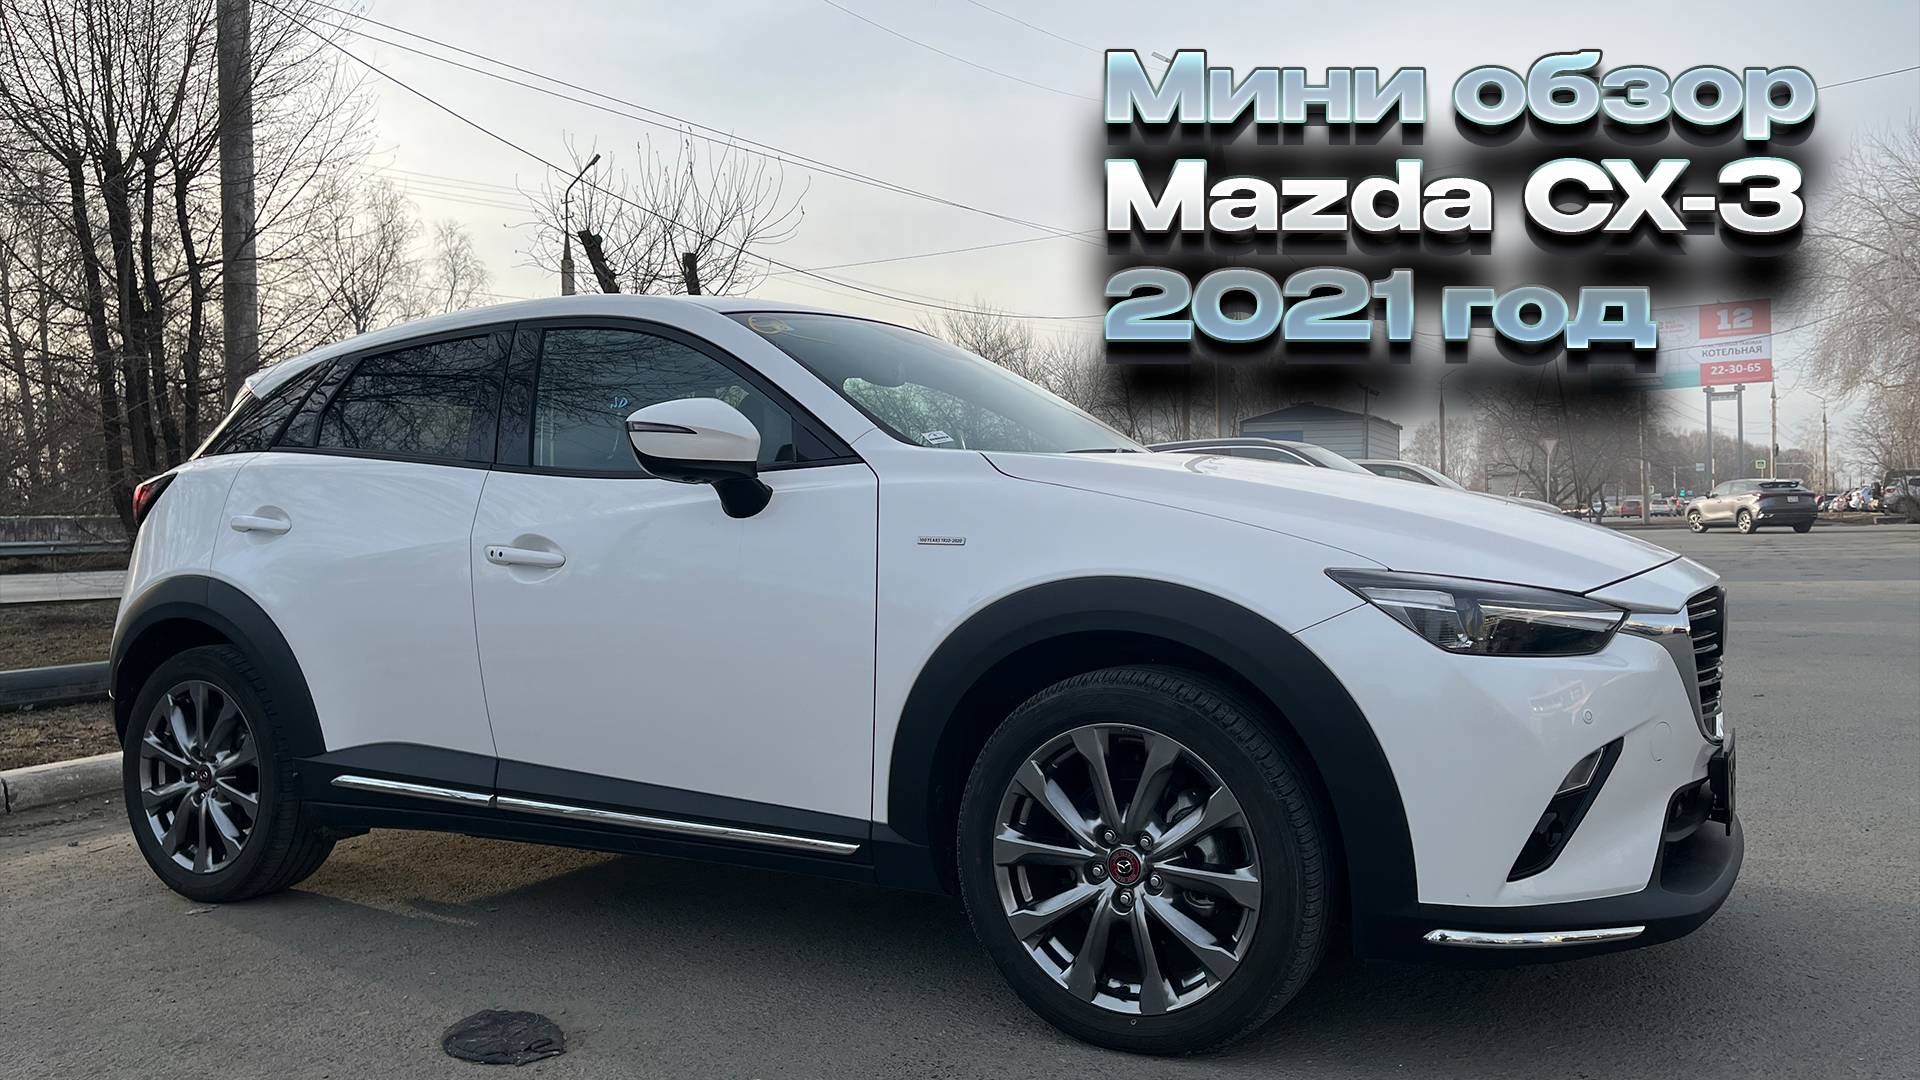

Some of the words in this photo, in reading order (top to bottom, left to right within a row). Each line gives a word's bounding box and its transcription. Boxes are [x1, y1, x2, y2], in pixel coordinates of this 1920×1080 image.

[1716, 307, 1753, 330] 12
[1702, 345, 1763, 358] КОТЕЛЬНАЯ
[1711, 363, 1761, 375] 22-30-65
